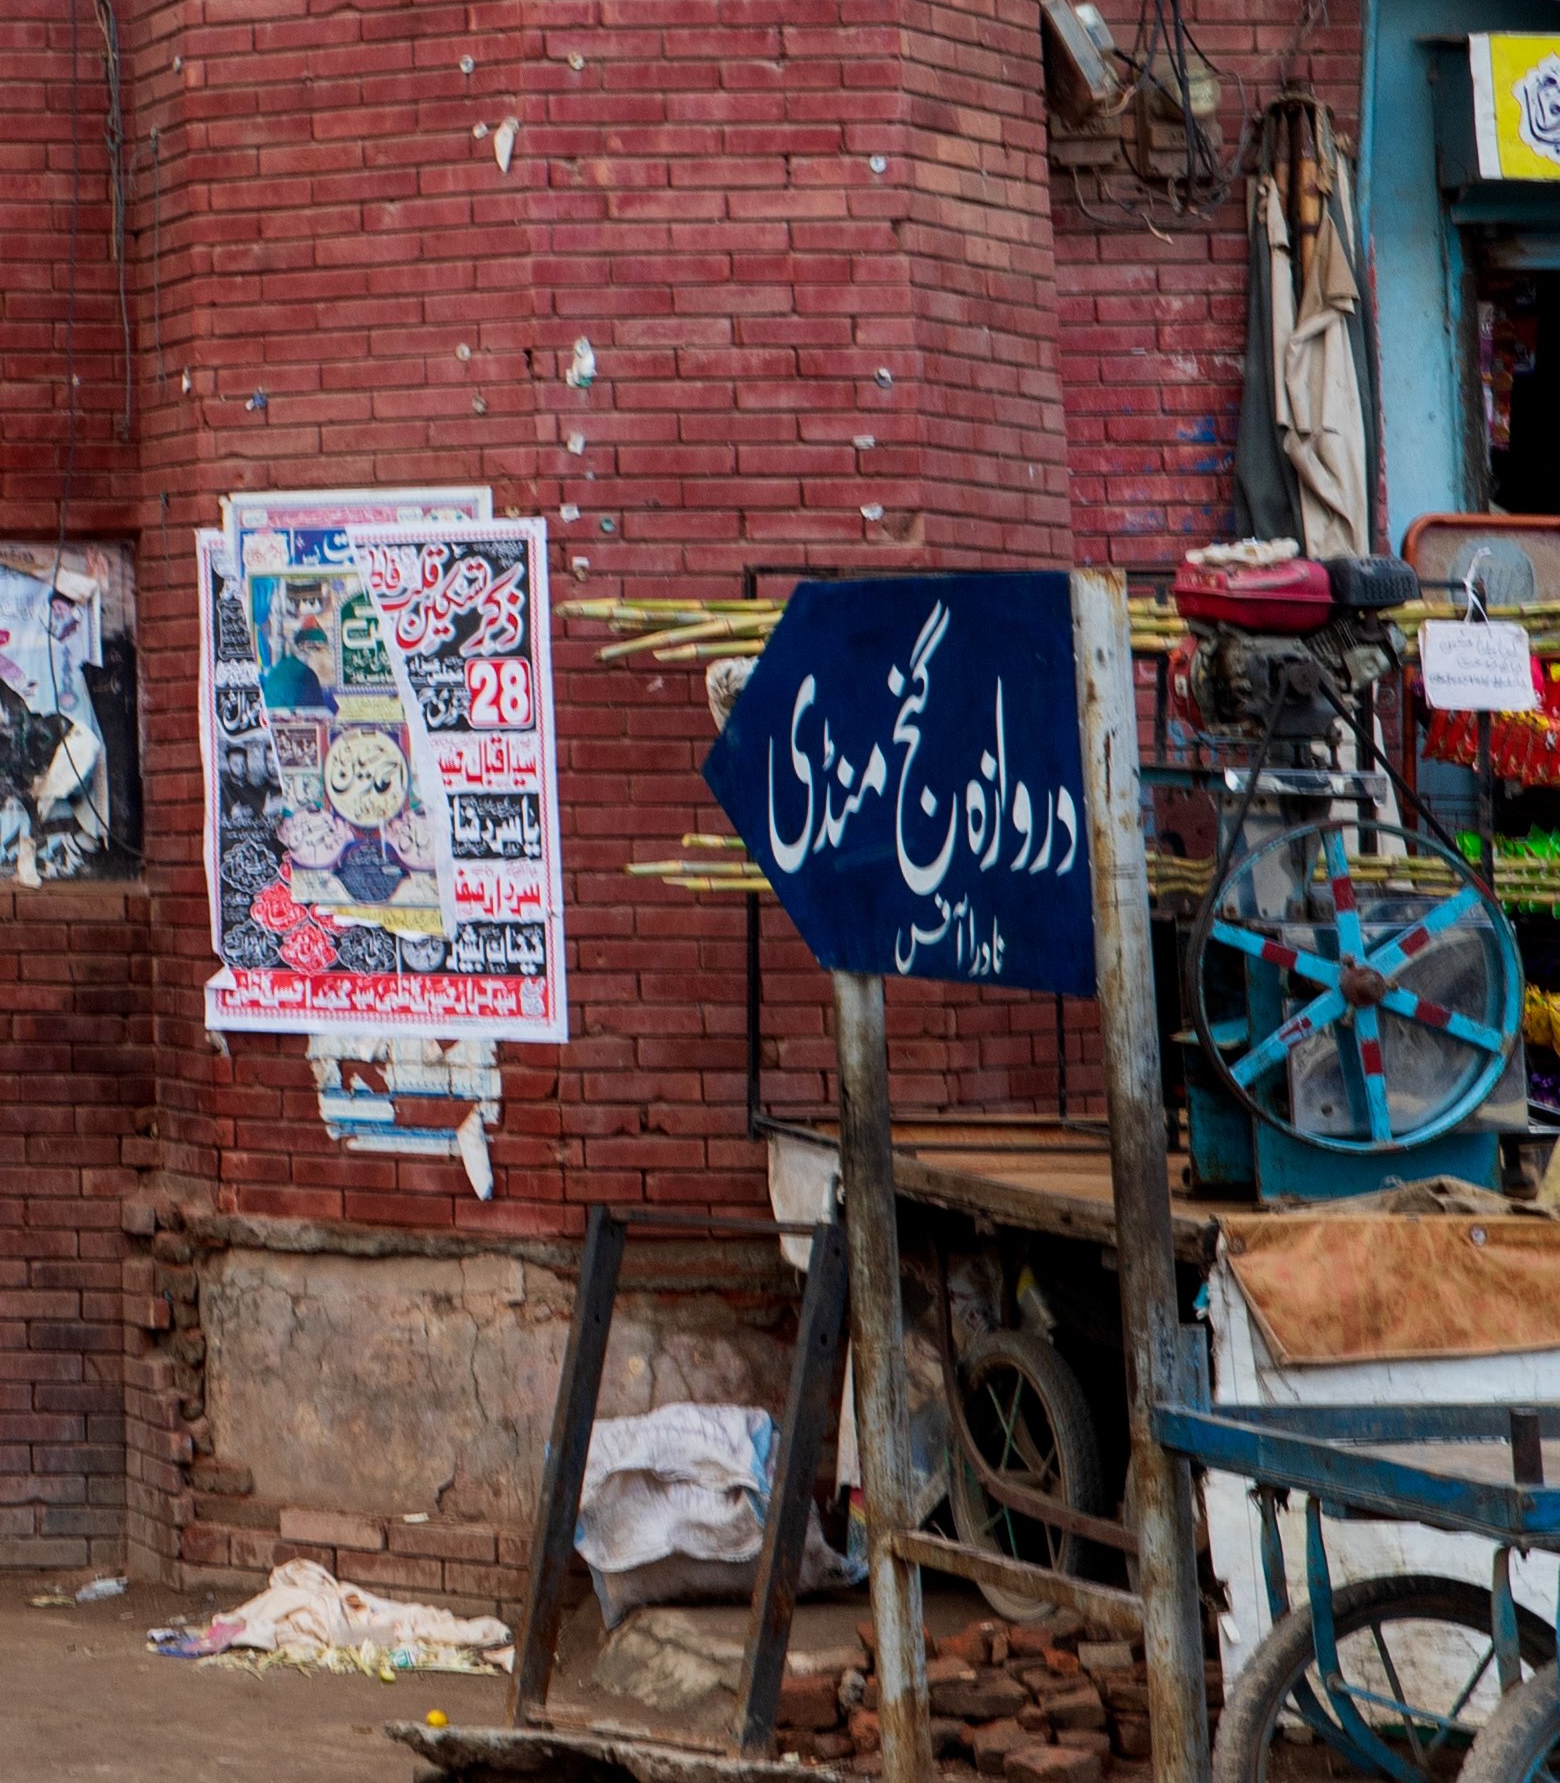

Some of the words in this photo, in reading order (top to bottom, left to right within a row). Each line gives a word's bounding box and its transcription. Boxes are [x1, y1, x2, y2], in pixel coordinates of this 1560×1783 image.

[470, 660, 531, 726] 28
[768, 674, 888, 875] منڈی
[966, 674, 1078, 877] دروازہ
